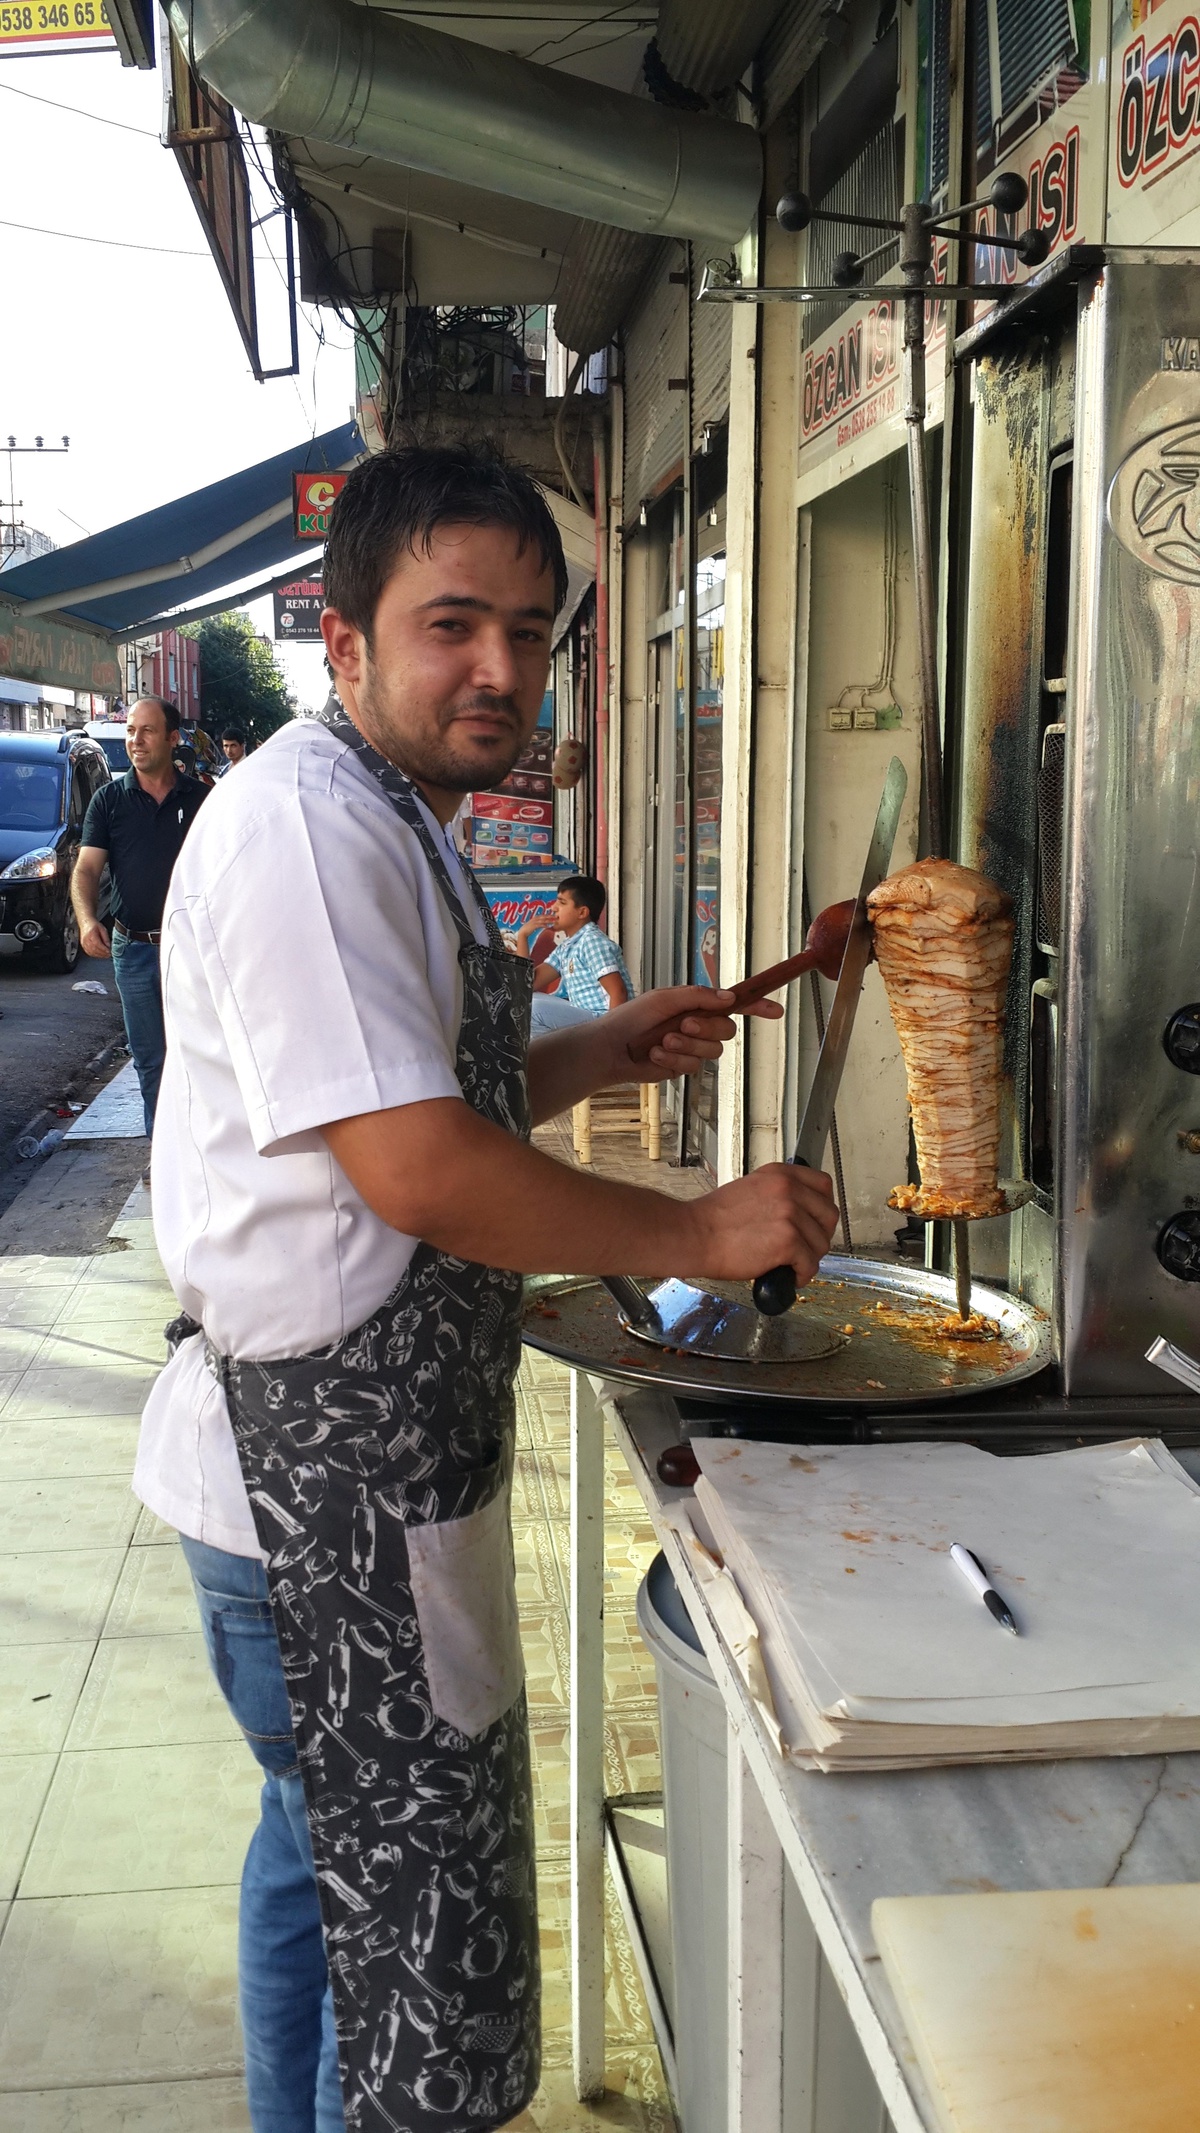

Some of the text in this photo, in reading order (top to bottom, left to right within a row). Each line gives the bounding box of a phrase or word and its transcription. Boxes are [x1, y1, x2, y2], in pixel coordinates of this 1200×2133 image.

[0, 1, 111, 32] 538 346 65 8
[1117, 16, 1200, 189] ÖZC
[803, 319, 862, 437] ÖZCAN
[285, 599, 310, 609] RENT
[313, 599, 321, 609] A
